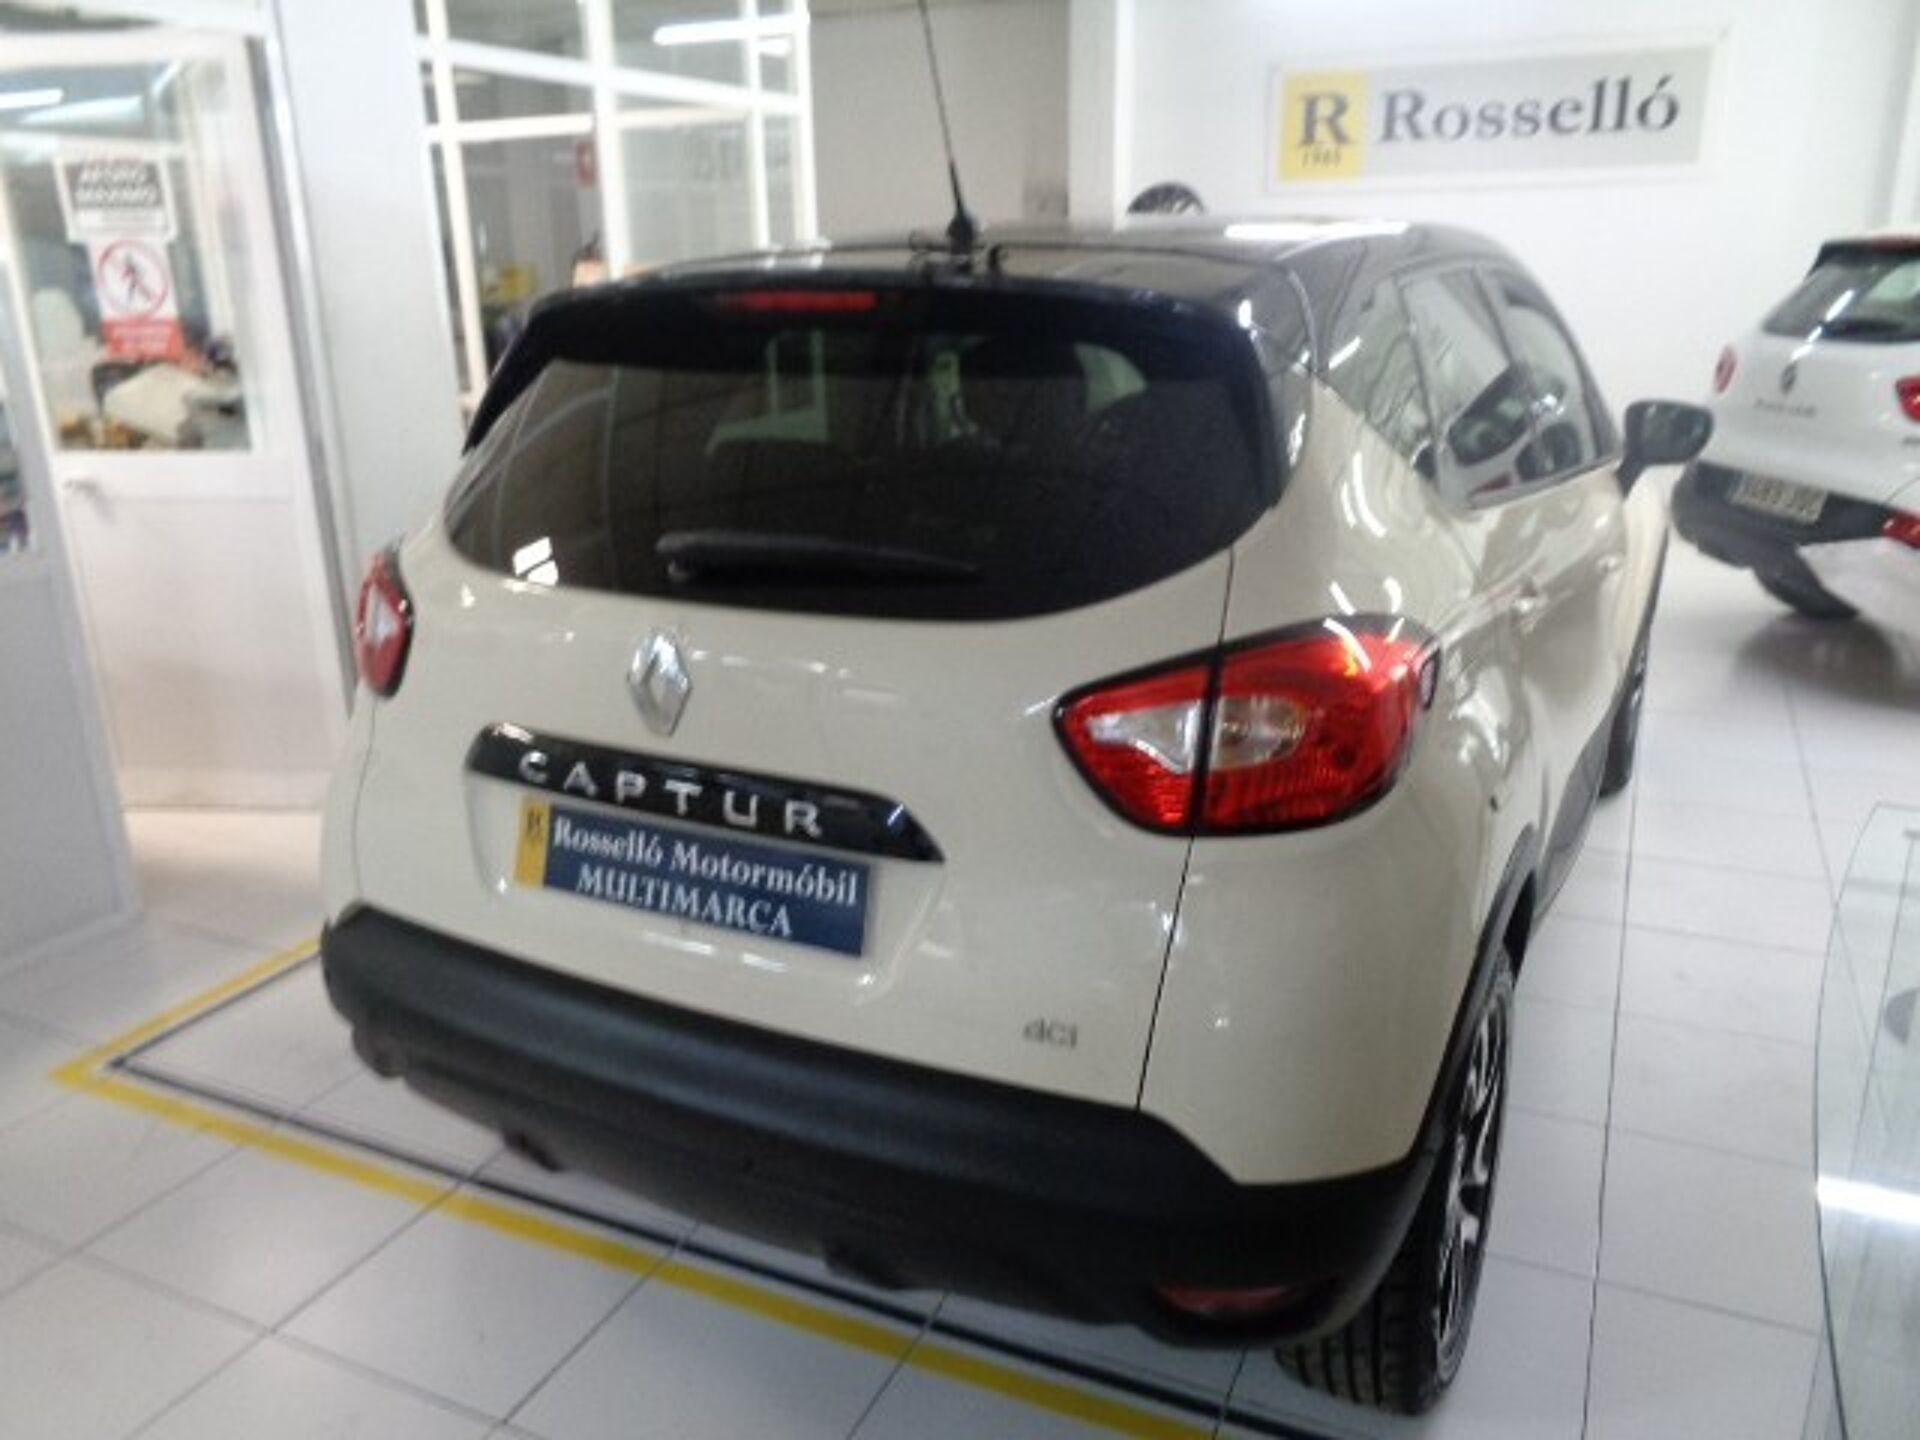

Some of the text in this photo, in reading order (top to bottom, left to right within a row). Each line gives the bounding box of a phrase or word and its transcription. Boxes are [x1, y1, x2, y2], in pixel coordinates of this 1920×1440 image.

[1297, 75, 1681, 147] R Rosselló
[518, 751, 823, 838] CAPTUR
[552, 815, 664, 868] Rosselló
[670, 839, 859, 907] Motormóbil
[575, 862, 793, 938] MULTIMARCA
